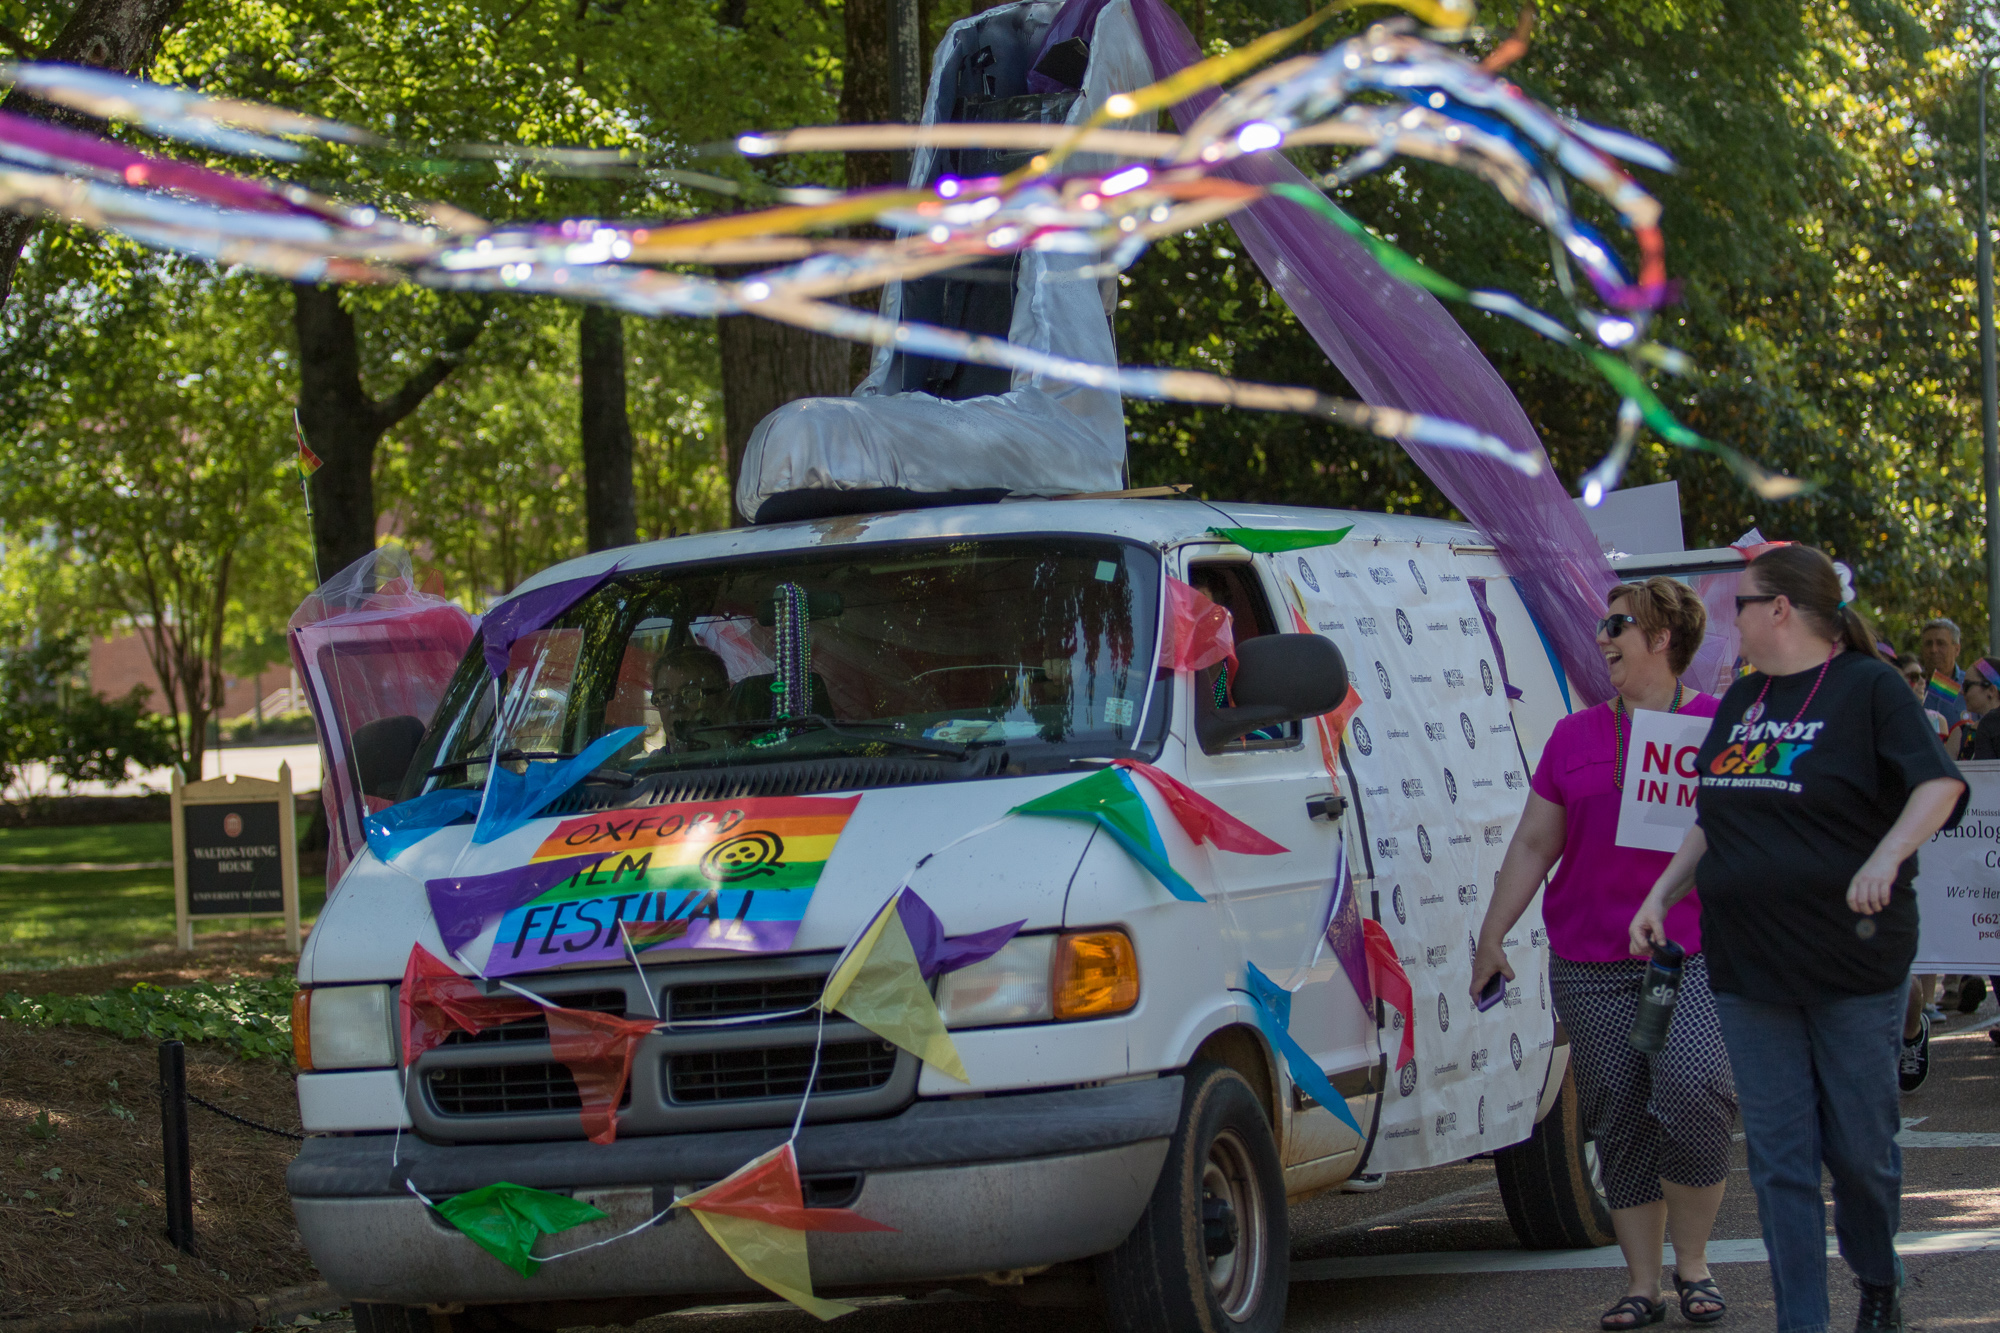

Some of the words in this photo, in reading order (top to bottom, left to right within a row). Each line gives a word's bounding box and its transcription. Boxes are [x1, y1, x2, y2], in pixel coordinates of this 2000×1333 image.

[1763, 720, 1825, 741] NOT
[1710, 742, 1813, 777] GAY
[1637, 779, 1669, 805] IN
[1676, 783, 1699, 808] M
[1731, 778, 1788, 791] BOYFRIEND
[1788, 782, 1803, 794] IS
[565, 809, 746, 846] OXFORD
[193, 845, 277, 859] WALTON-YOUNG
[218, 861, 254, 873] HOUSE
[568, 852, 653, 888] ILM
[1946, 886, 1980, 898] We're
[511, 889, 756, 958] FESTIVAL
[1972, 912, 2000, 927] (662
